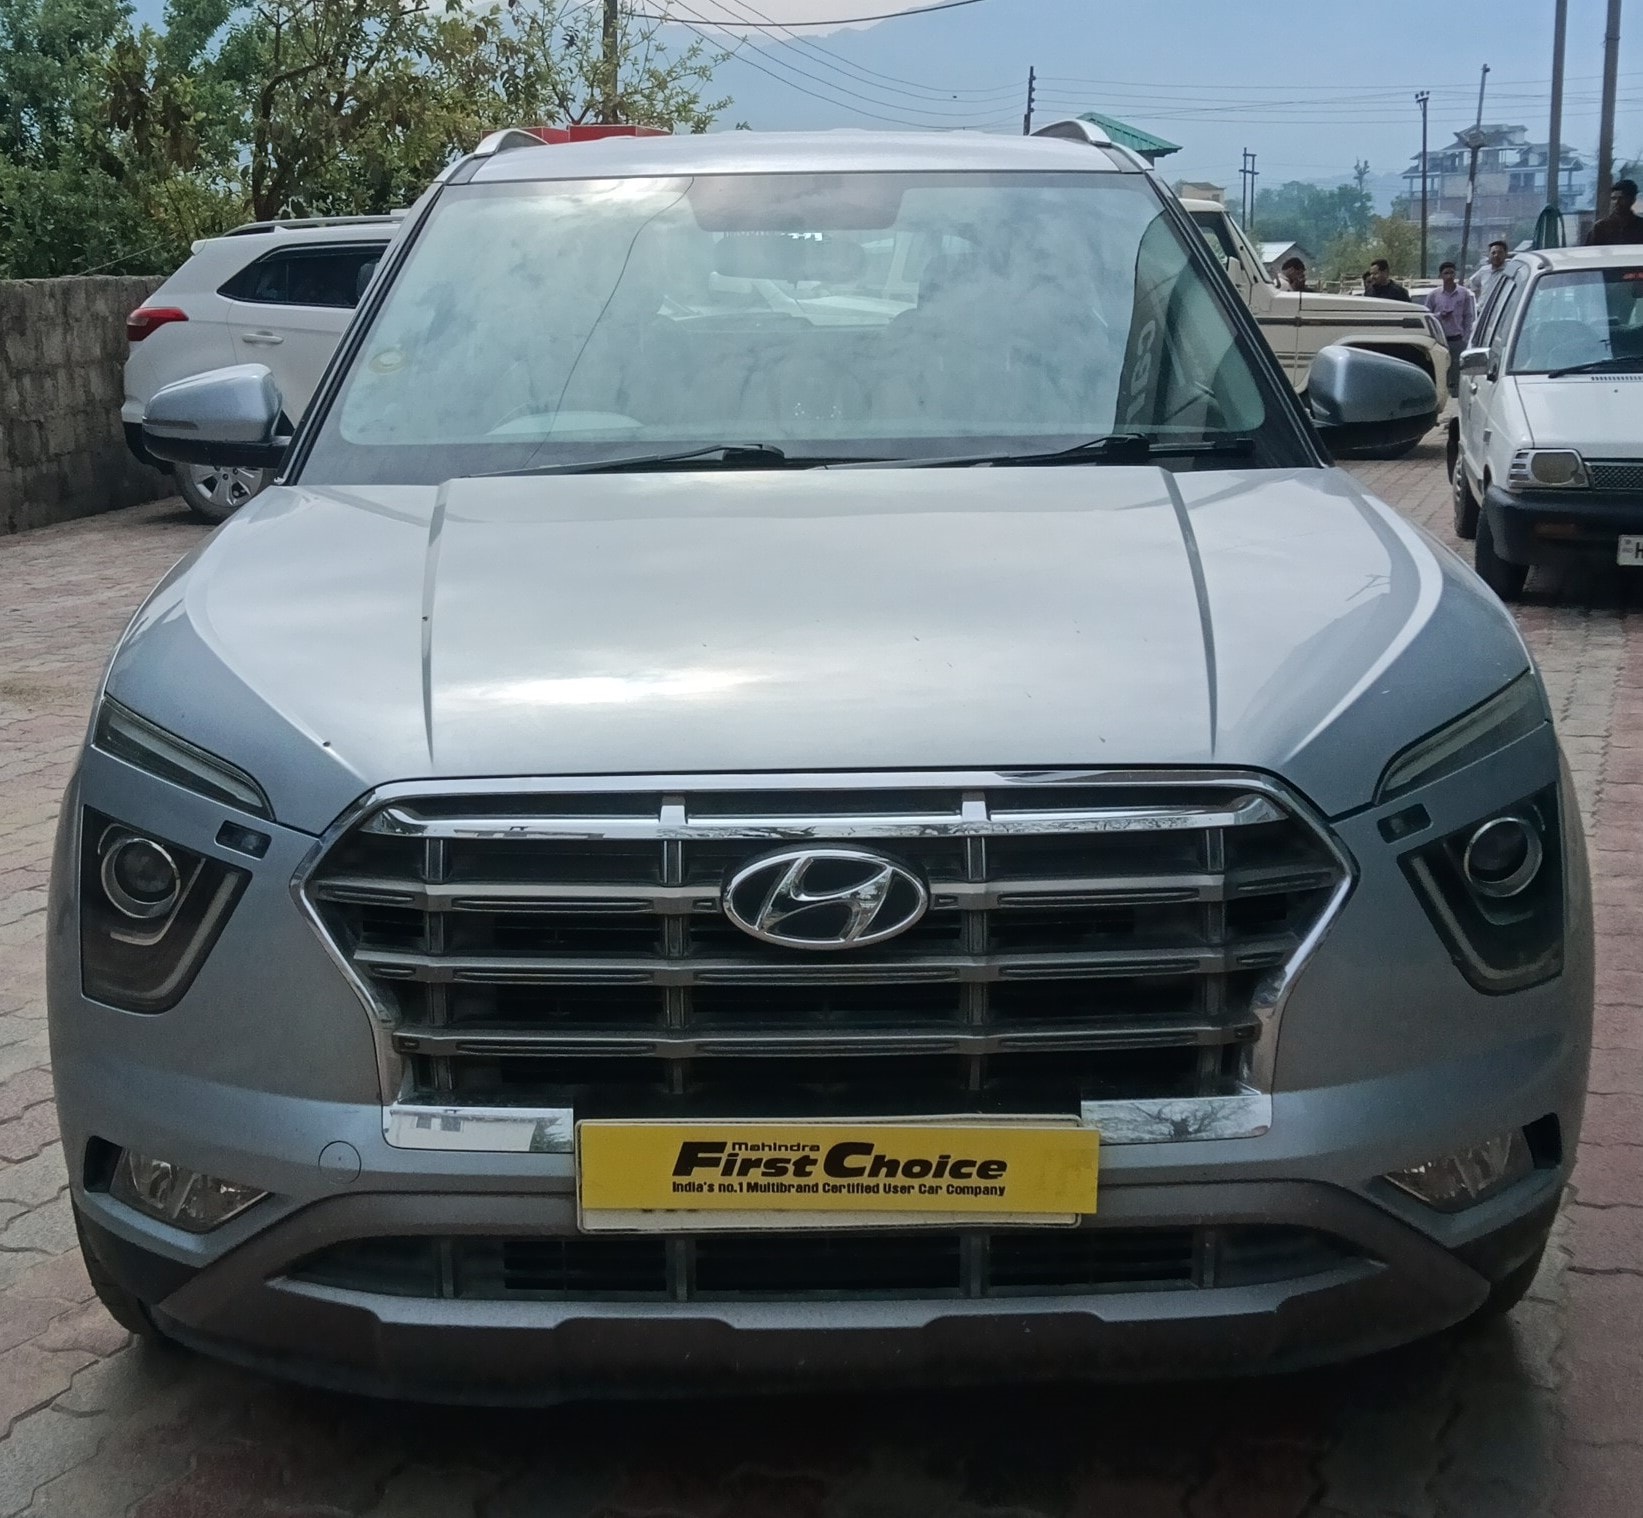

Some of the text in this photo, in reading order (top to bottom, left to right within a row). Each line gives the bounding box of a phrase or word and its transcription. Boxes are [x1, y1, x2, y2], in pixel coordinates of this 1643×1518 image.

[732, 1142, 820, 1151] Mahindra
[672, 1141, 1007, 1179] First Choice
[672, 1181, 715, 1193] India's
[746, 1182, 819, 1193] Multibrand
[822, 1182, 880, 1194] Certified
[883, 1183, 915, 1194] User
[918, 1184, 943, 1195] Car
[946, 1184, 1006, 1197] Company
